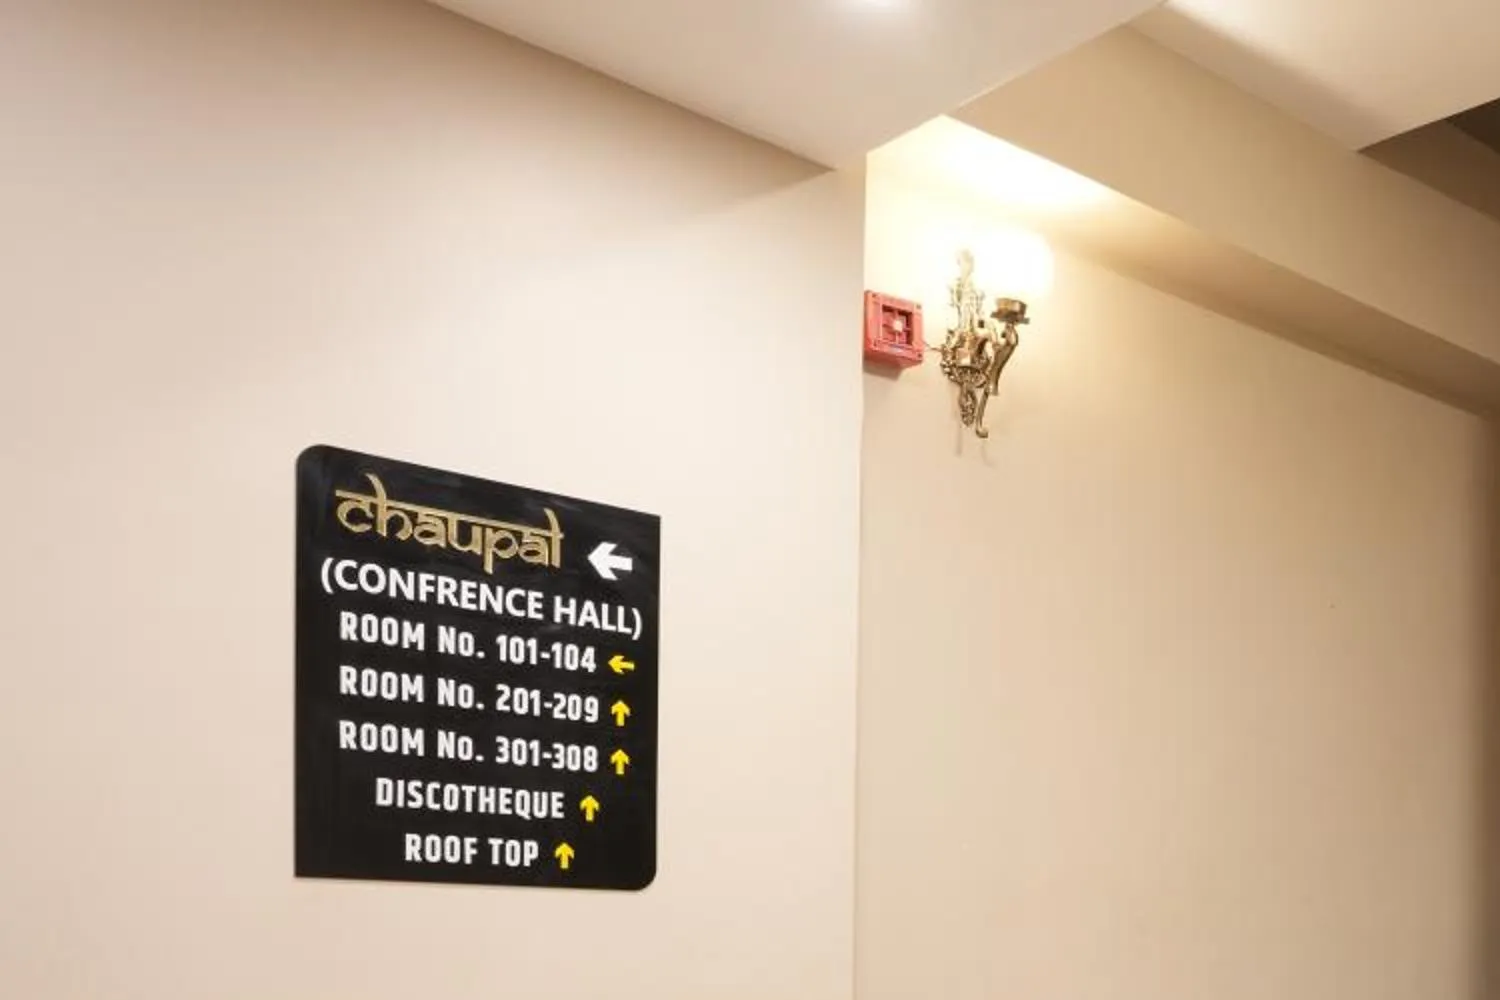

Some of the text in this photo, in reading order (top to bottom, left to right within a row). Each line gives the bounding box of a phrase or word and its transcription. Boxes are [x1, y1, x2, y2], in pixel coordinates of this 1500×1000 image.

[335, 472, 565, 575] chaupal
[320, 557, 643, 640] (CONFRENCE HALL)
[340, 611, 597, 673] ROOM No. 101-104
[339, 666, 599, 723] ROOM No. 201-209
[339, 720, 598, 773] ROOM No. 301-308
[375, 777, 565, 820] DISCOTHEQUE
[405, 833, 539, 867] ROOF TOP
